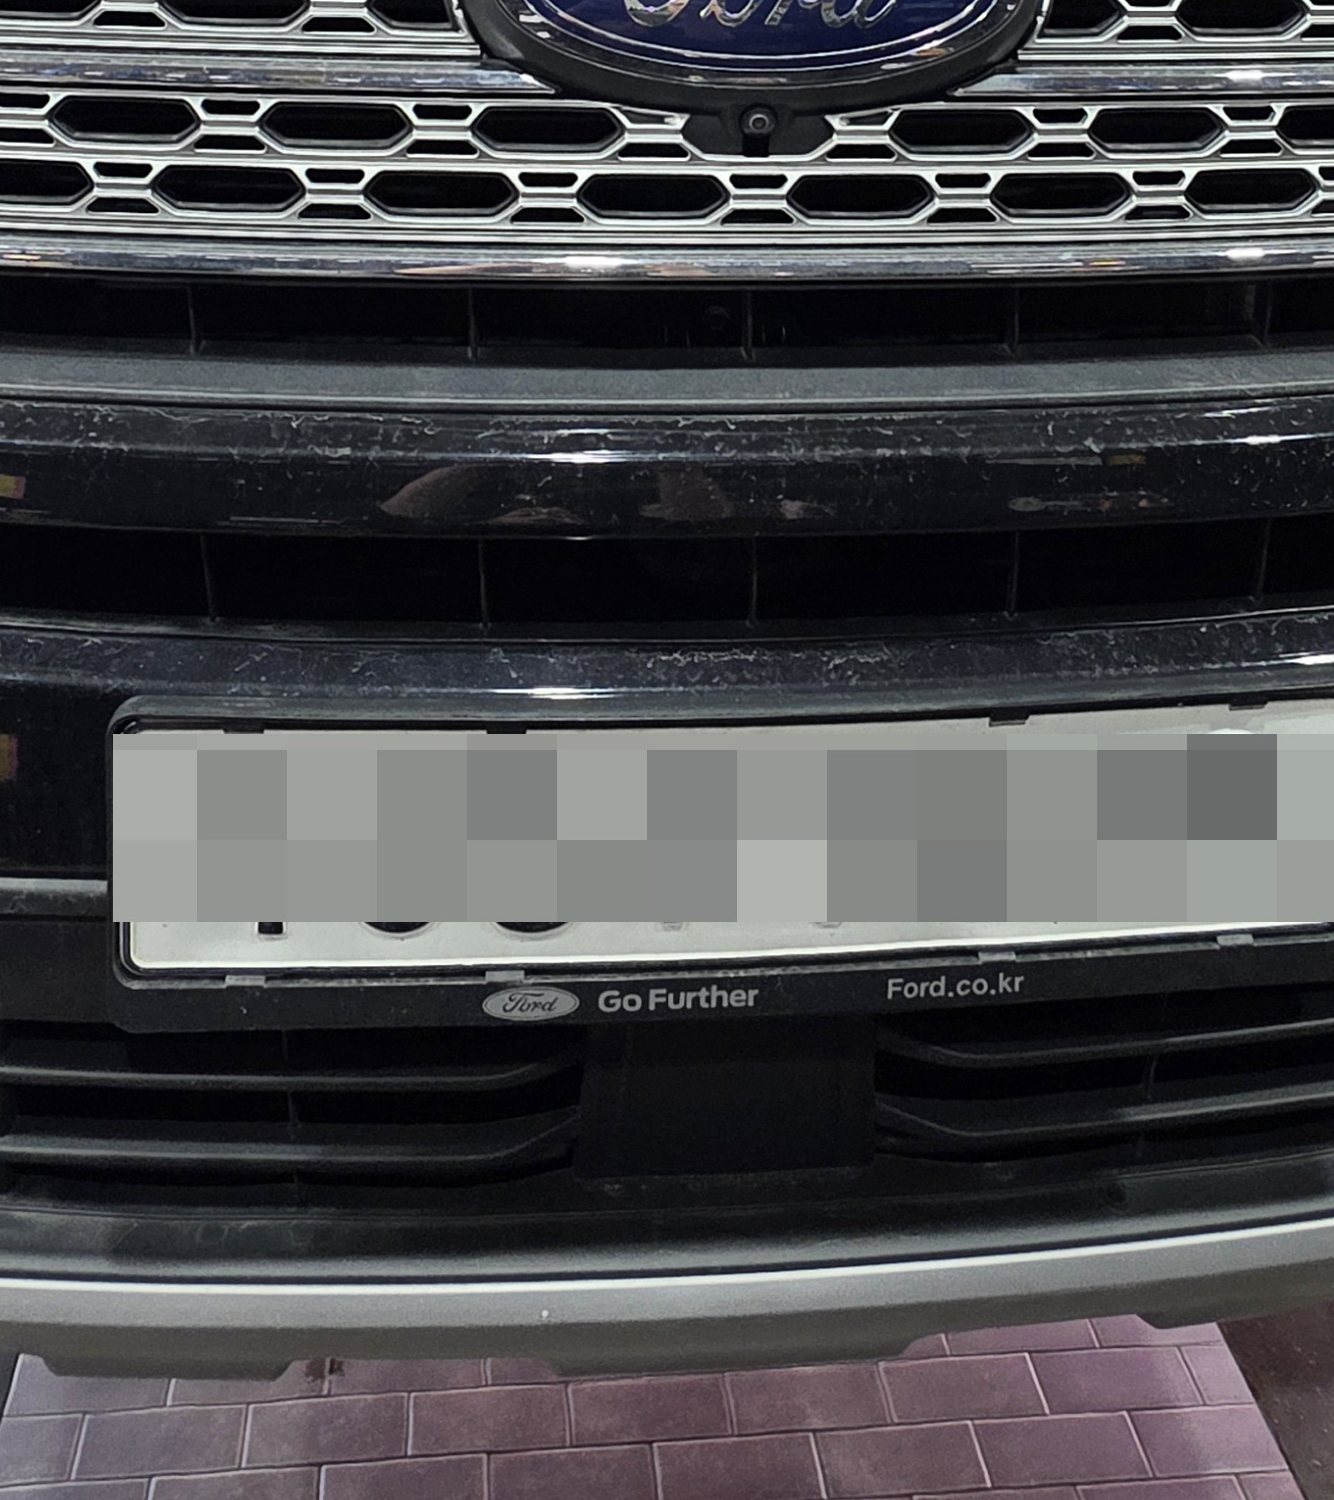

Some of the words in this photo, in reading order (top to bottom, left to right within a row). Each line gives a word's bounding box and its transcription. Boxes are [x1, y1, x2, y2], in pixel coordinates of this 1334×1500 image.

[502, 991, 557, 1013] Ford
[597, 990, 642, 1012] Go
[648, 984, 759, 1011] Further
[887, 972, 1025, 1000] Ford.co.kr
